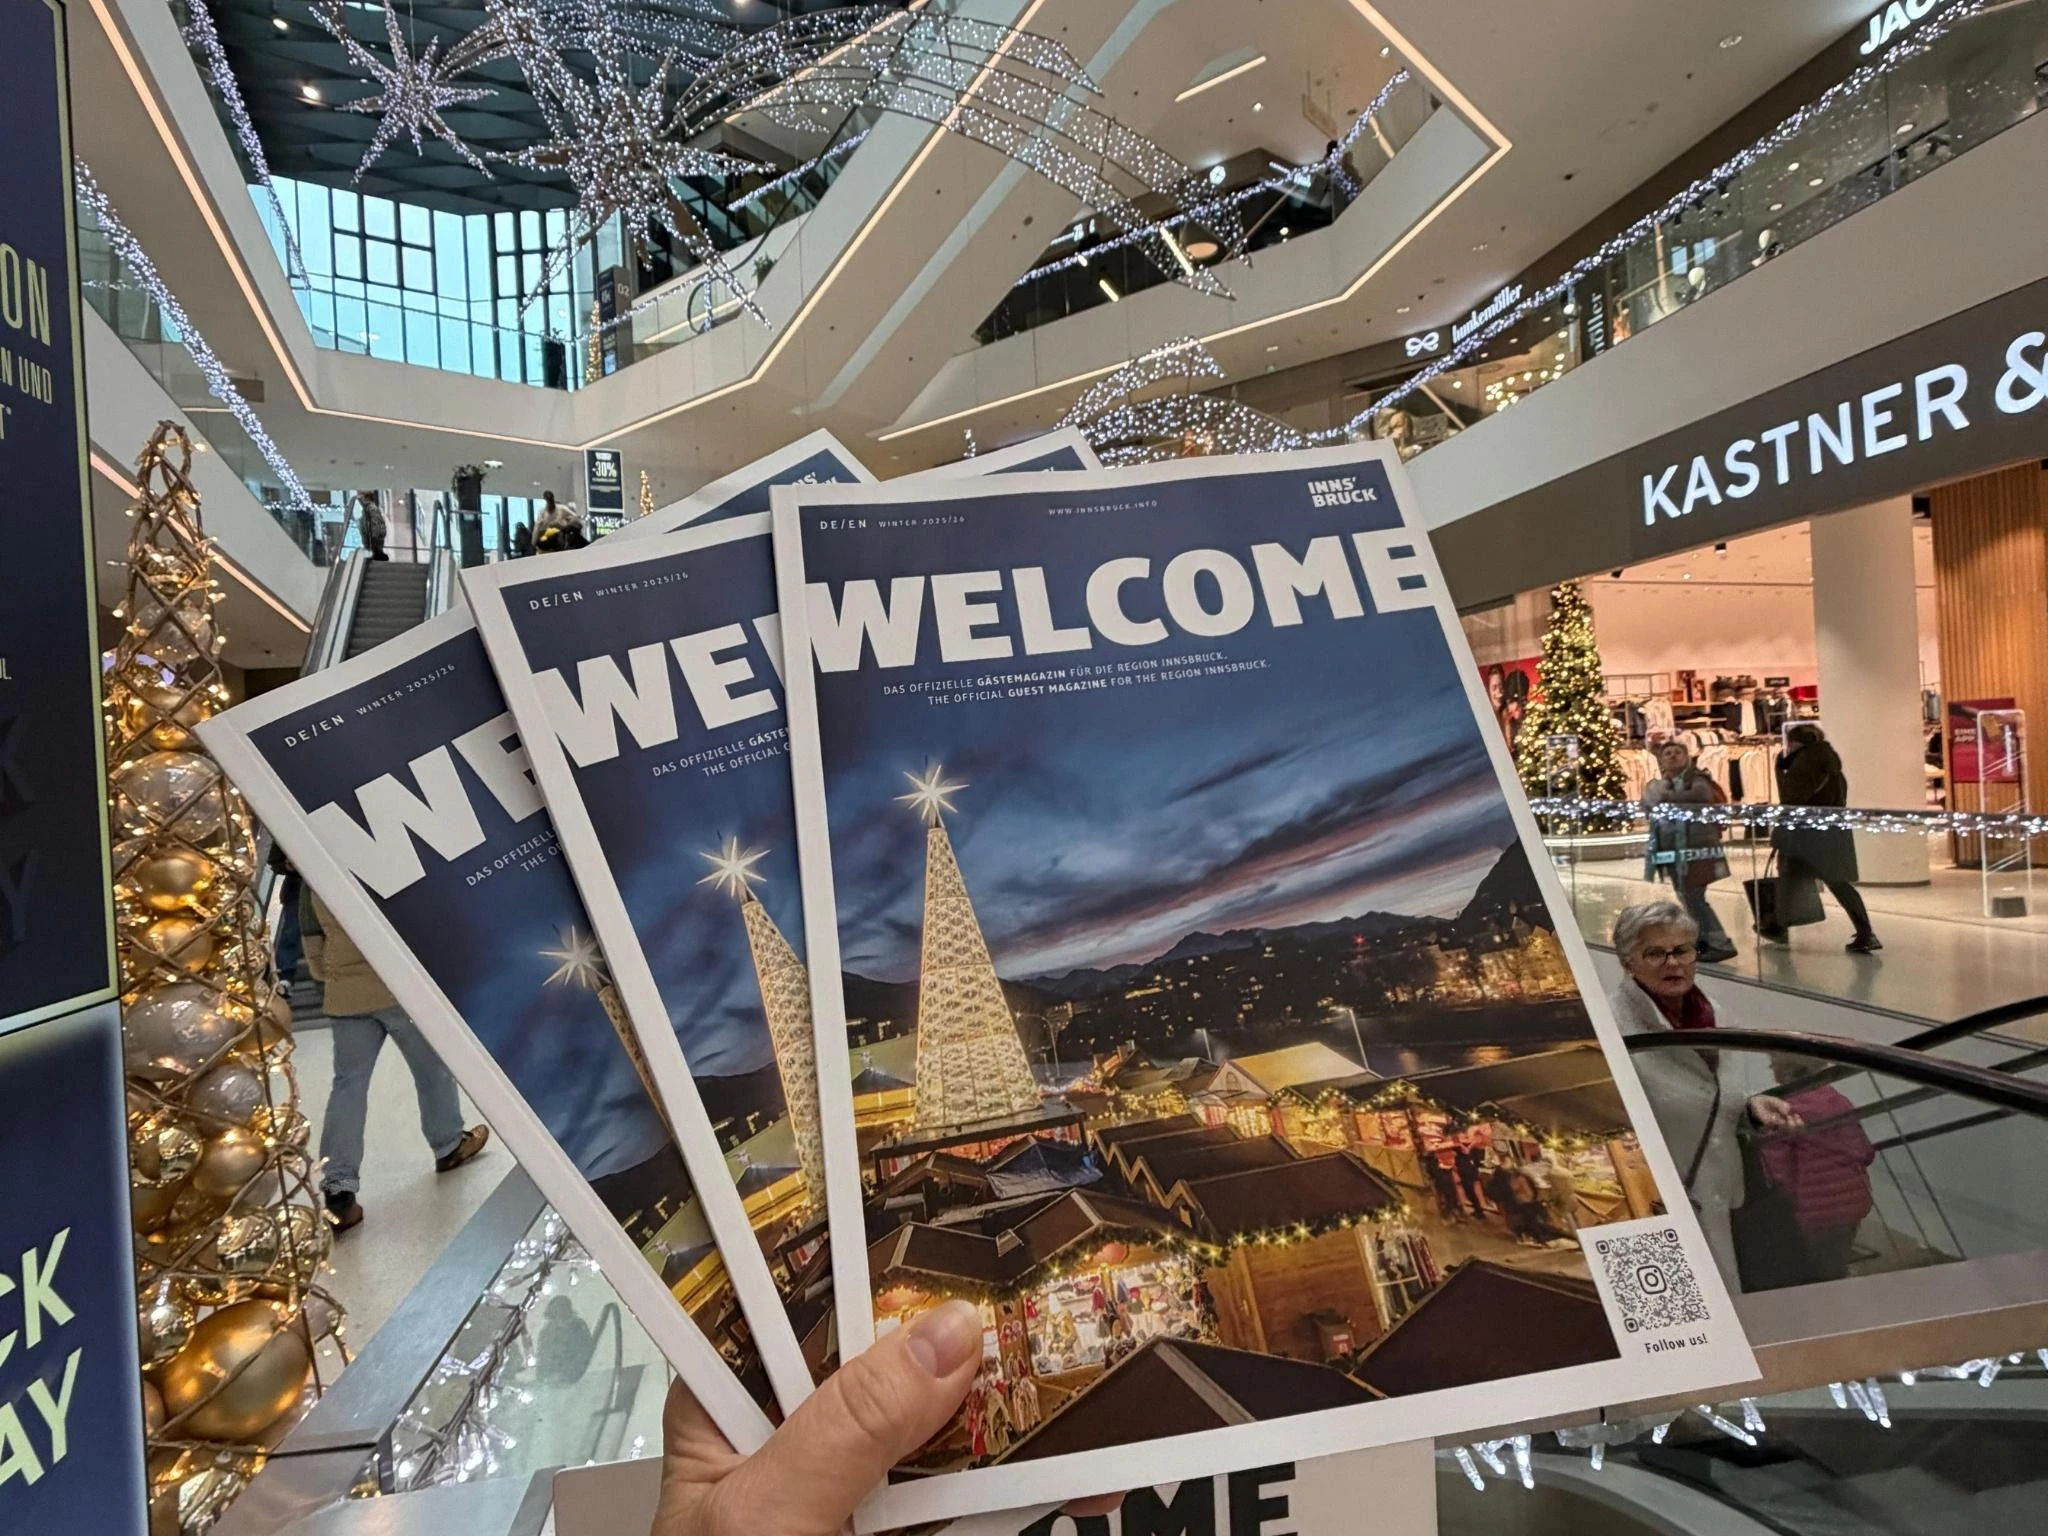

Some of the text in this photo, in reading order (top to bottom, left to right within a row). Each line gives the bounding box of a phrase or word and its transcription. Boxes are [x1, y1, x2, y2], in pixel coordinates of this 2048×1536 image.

[1860, 0, 1945, 55] JAC
[19, 356, 53, 404] UND
[1643, 331, 2048, 526] KASTNER &
[1307, 476, 1356, 495] INNS'
[1311, 488, 1377, 508] BRUCK
[819, 516, 966, 531] DE/EN WINTER 2025/26
[528, 571, 689, 611] DE/EN WINTER 2025/26
[804, 526, 1434, 673] WELCOME
[883, 651, 1228, 696] DAS OFFIZIELLE GÄSTEMAGAZIN FÜR DIE REGION INNSBRUCK.
[928, 659, 1272, 706] THE OFFICIAL GUEST MAGAZINE FOR THE REGION INNSBRUCK.
[284, 663, 456, 748] DE/EN WINTER 2025/26
[652, 761, 677, 777] DAS
[680, 740, 746, 768] OFFIZIELLE
[702, 762, 727, 777] THE
[729, 746, 781, 769] OFFICIAL
[465, 826, 556, 887] DAS OFFIZIELL
[520, 852, 547, 872] THE
[1644, 1332, 1708, 1354] Follow us!
